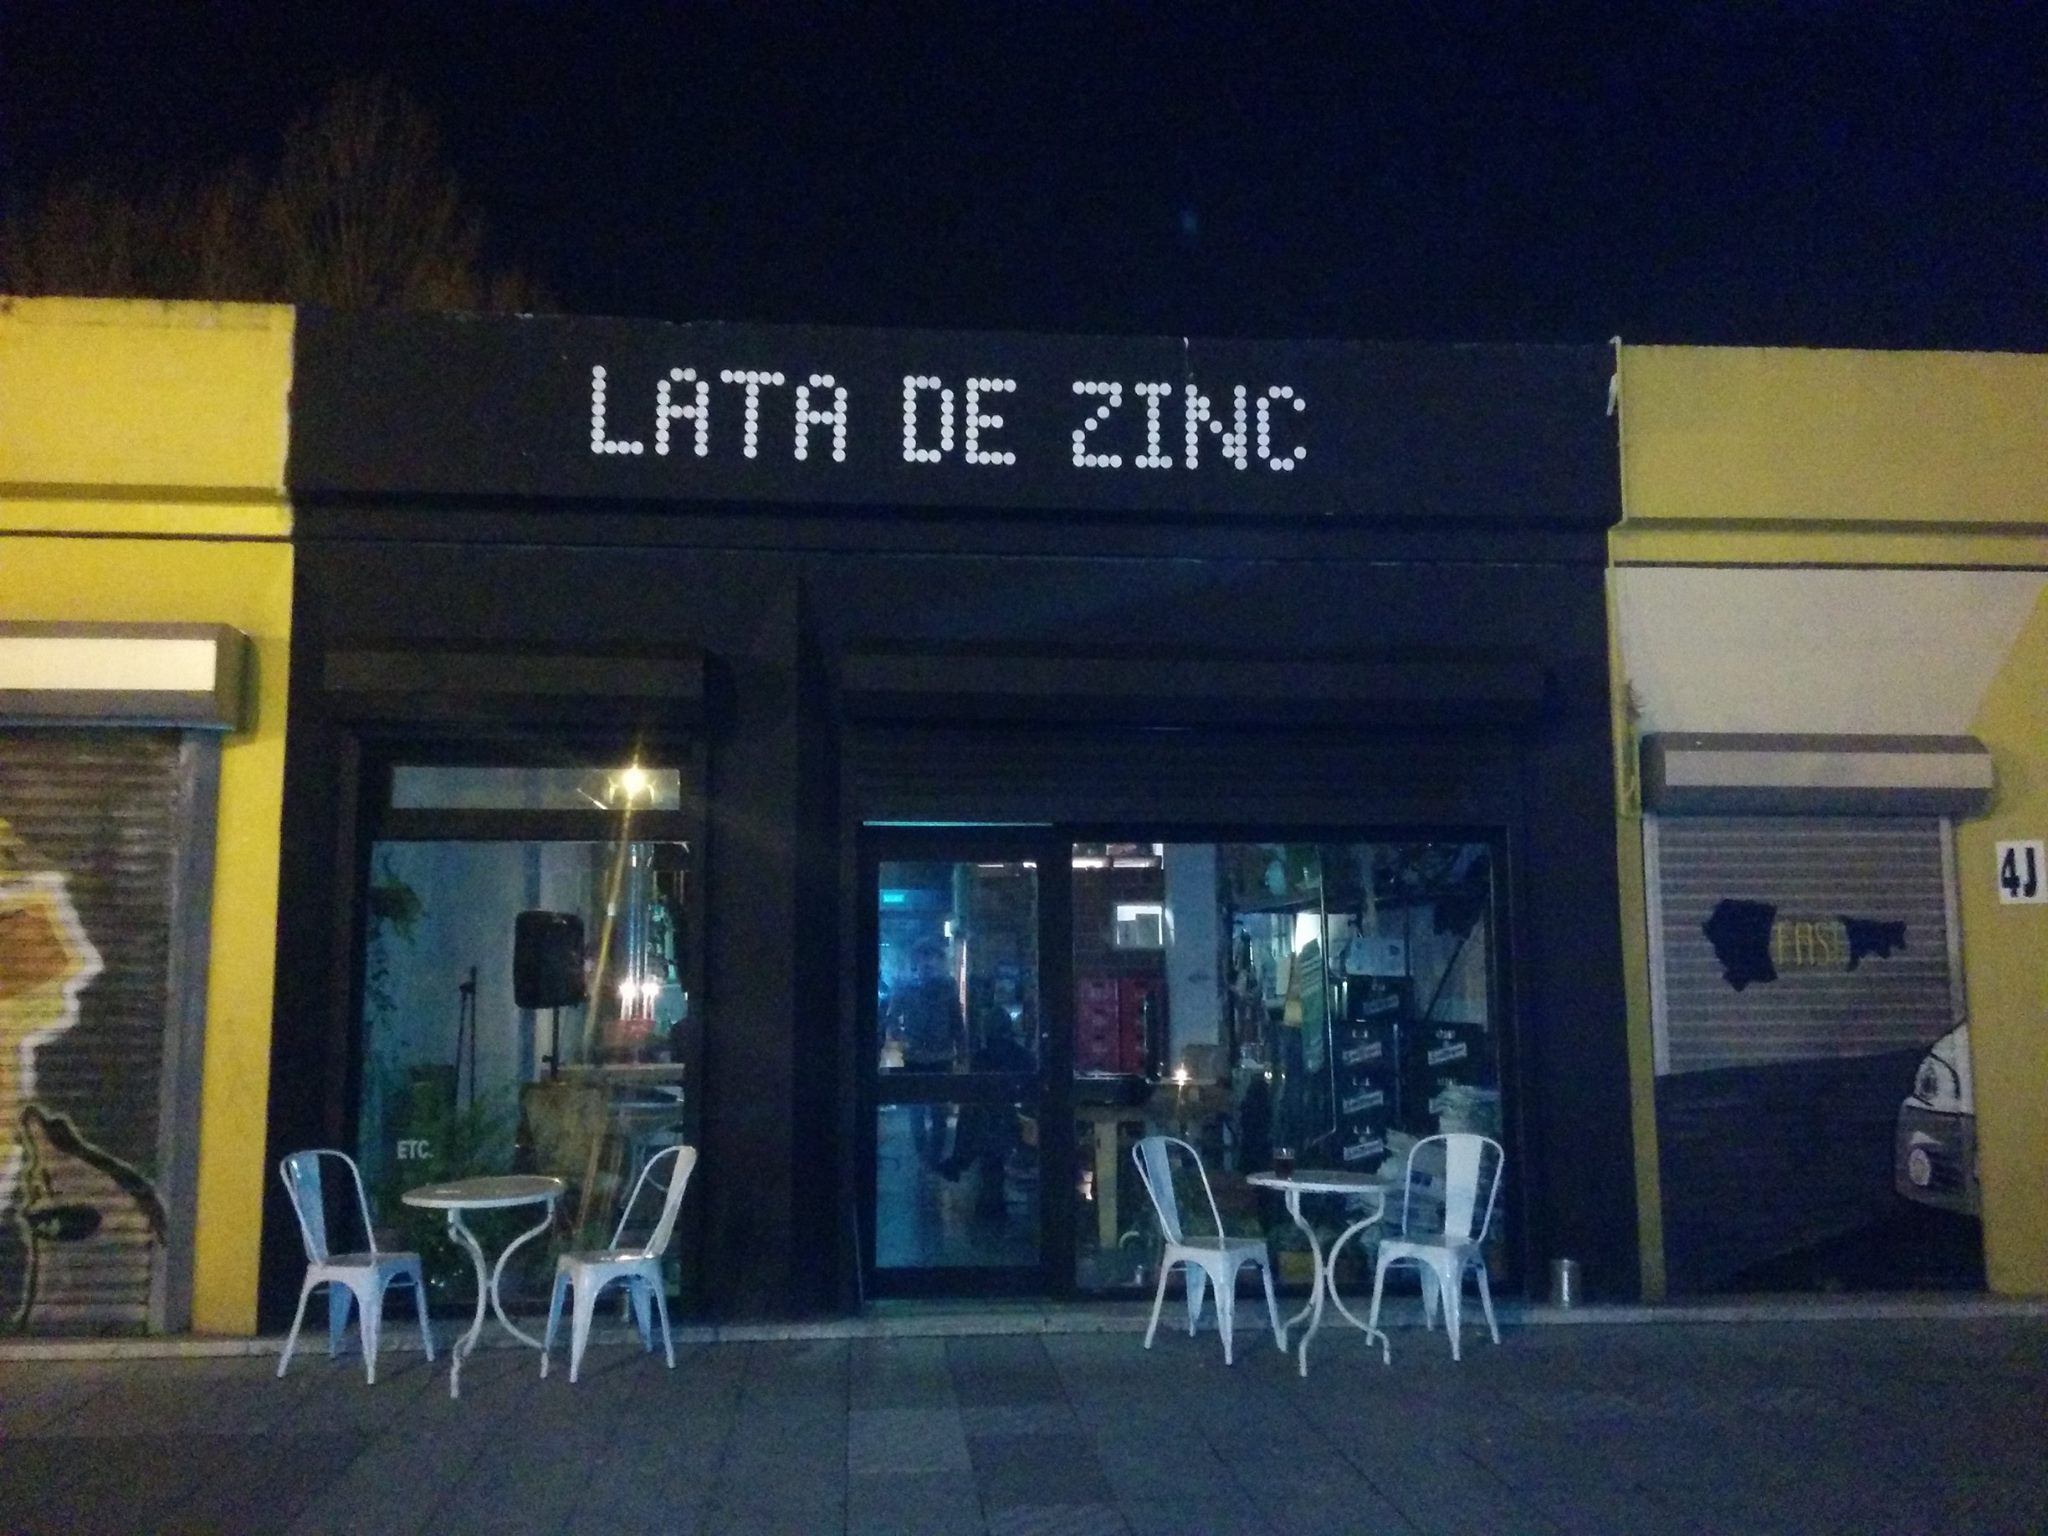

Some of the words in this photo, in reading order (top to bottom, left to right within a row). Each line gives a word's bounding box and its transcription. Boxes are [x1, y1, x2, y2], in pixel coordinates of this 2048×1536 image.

[590, 364, 848, 463] LATA
[902, 375, 1017, 466] DE
[1071, 382, 1307, 473] ZINC
